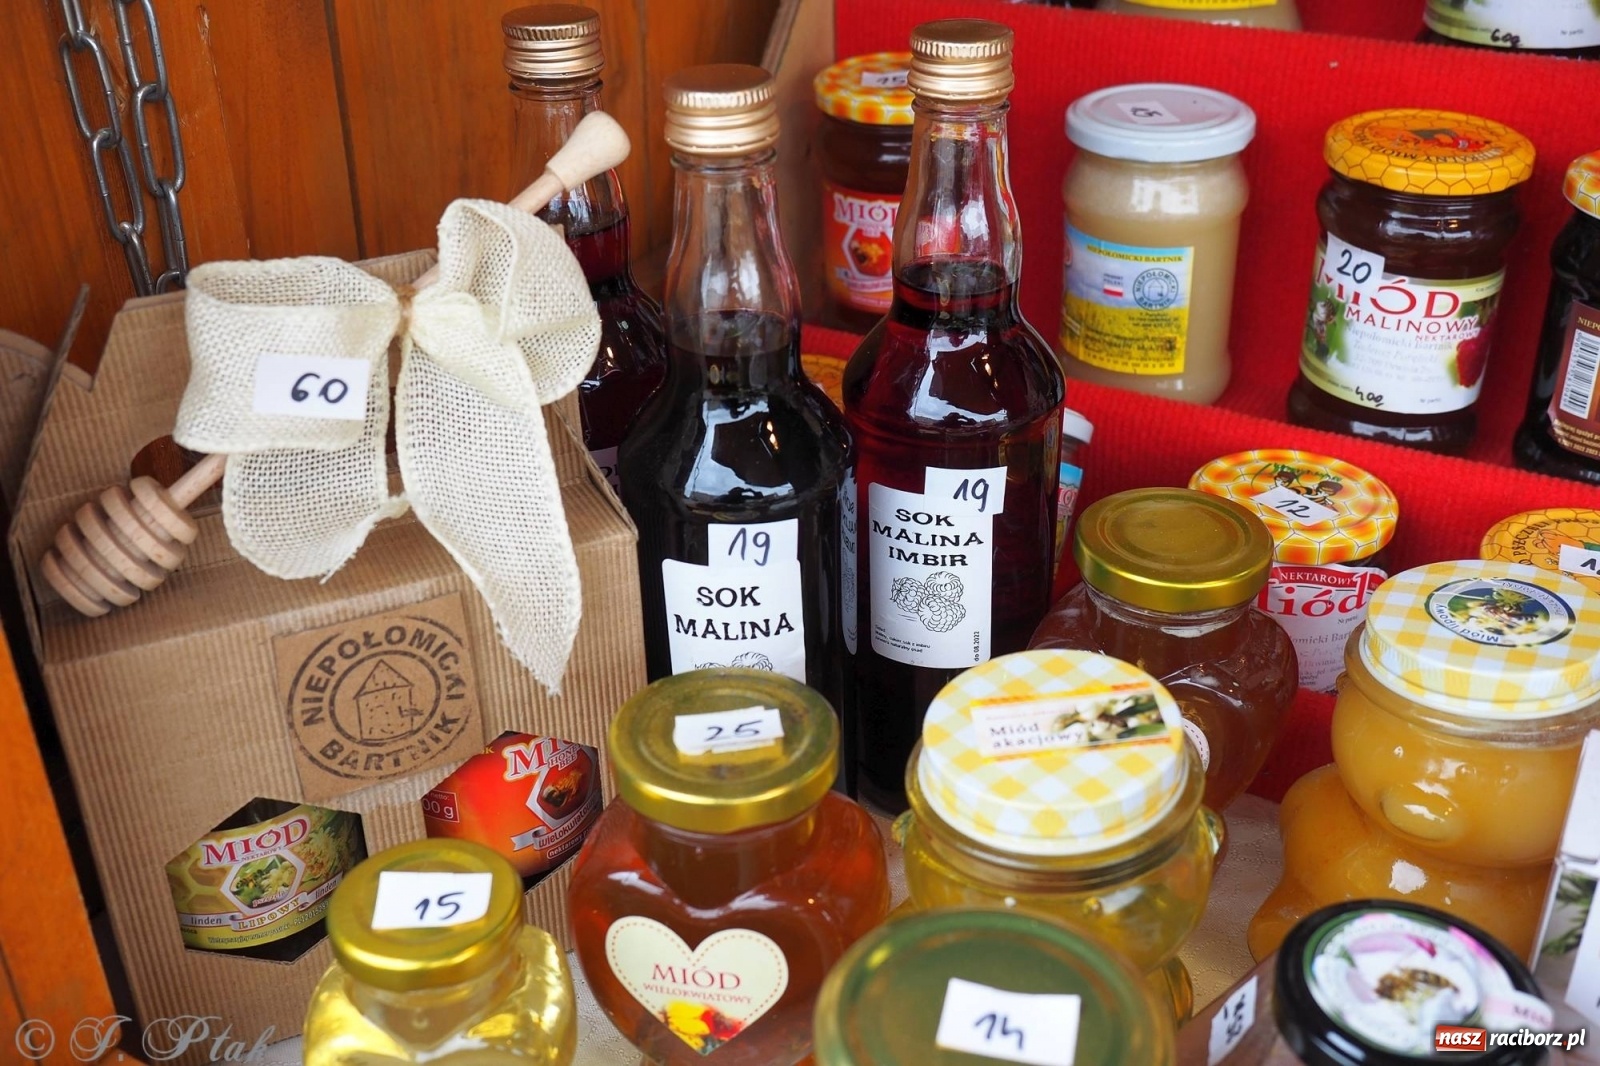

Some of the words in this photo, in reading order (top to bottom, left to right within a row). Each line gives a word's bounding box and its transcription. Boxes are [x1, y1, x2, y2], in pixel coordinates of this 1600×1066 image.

[1337, 249, 1371, 284] 20
[1345, 306, 1477, 335] MALINOWY
[291, 373, 348, 404] 60
[952, 478, 990, 513] 19
[895, 508, 955, 527] SOK
[1275, 500, 1310, 519] 12
[728, 527, 771, 567] 19
[872, 520, 985, 547] MALINA
[888, 546, 968, 567] IMBIR
[1580, 558, 1600, 576] 1
[1280, 571, 1353, 586] NEKTAROWY
[696, 586, 761, 608] SOK
[673, 612, 795, 641] MALINA
[301, 625, 467, 727] NIEPOŁOMICKI
[319, 711, 461, 772] BARTNIK
[705, 719, 763, 743] 25
[443, 806, 454, 819] g
[202, 818, 309, 865] MIÓD
[314, 879, 337, 899] linden
[238, 897, 300, 930] LIPOWY
[415, 891, 465, 920] 15
[190, 916, 222, 926] linden
[652, 963, 741, 990] MIÓD
[642, 982, 752, 1005] WIELOKWIATOWY
[974, 1013, 1024, 1051] 14
